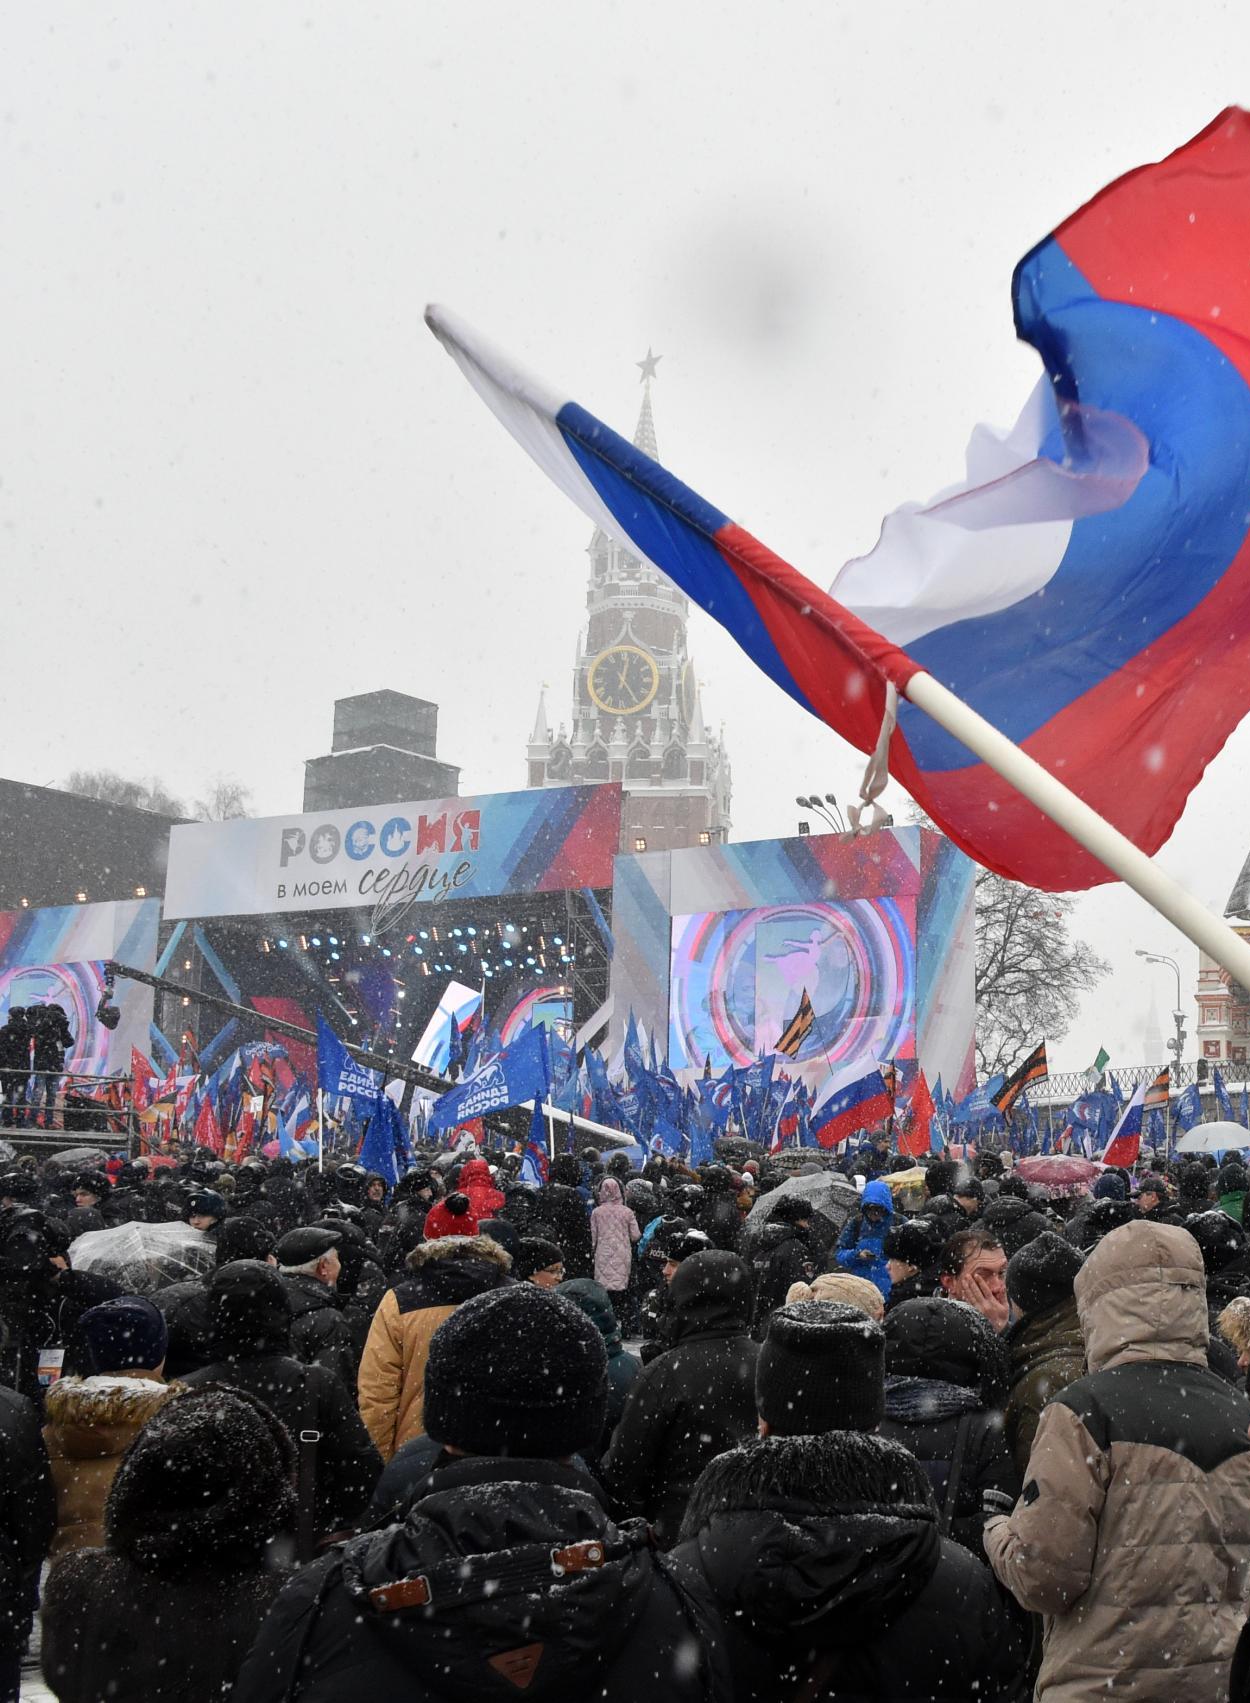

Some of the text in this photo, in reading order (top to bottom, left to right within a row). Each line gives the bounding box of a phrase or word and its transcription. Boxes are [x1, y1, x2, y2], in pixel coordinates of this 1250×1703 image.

[279, 809, 481, 868] РОССИЯ
[277, 861, 478, 936] в моем сердце
